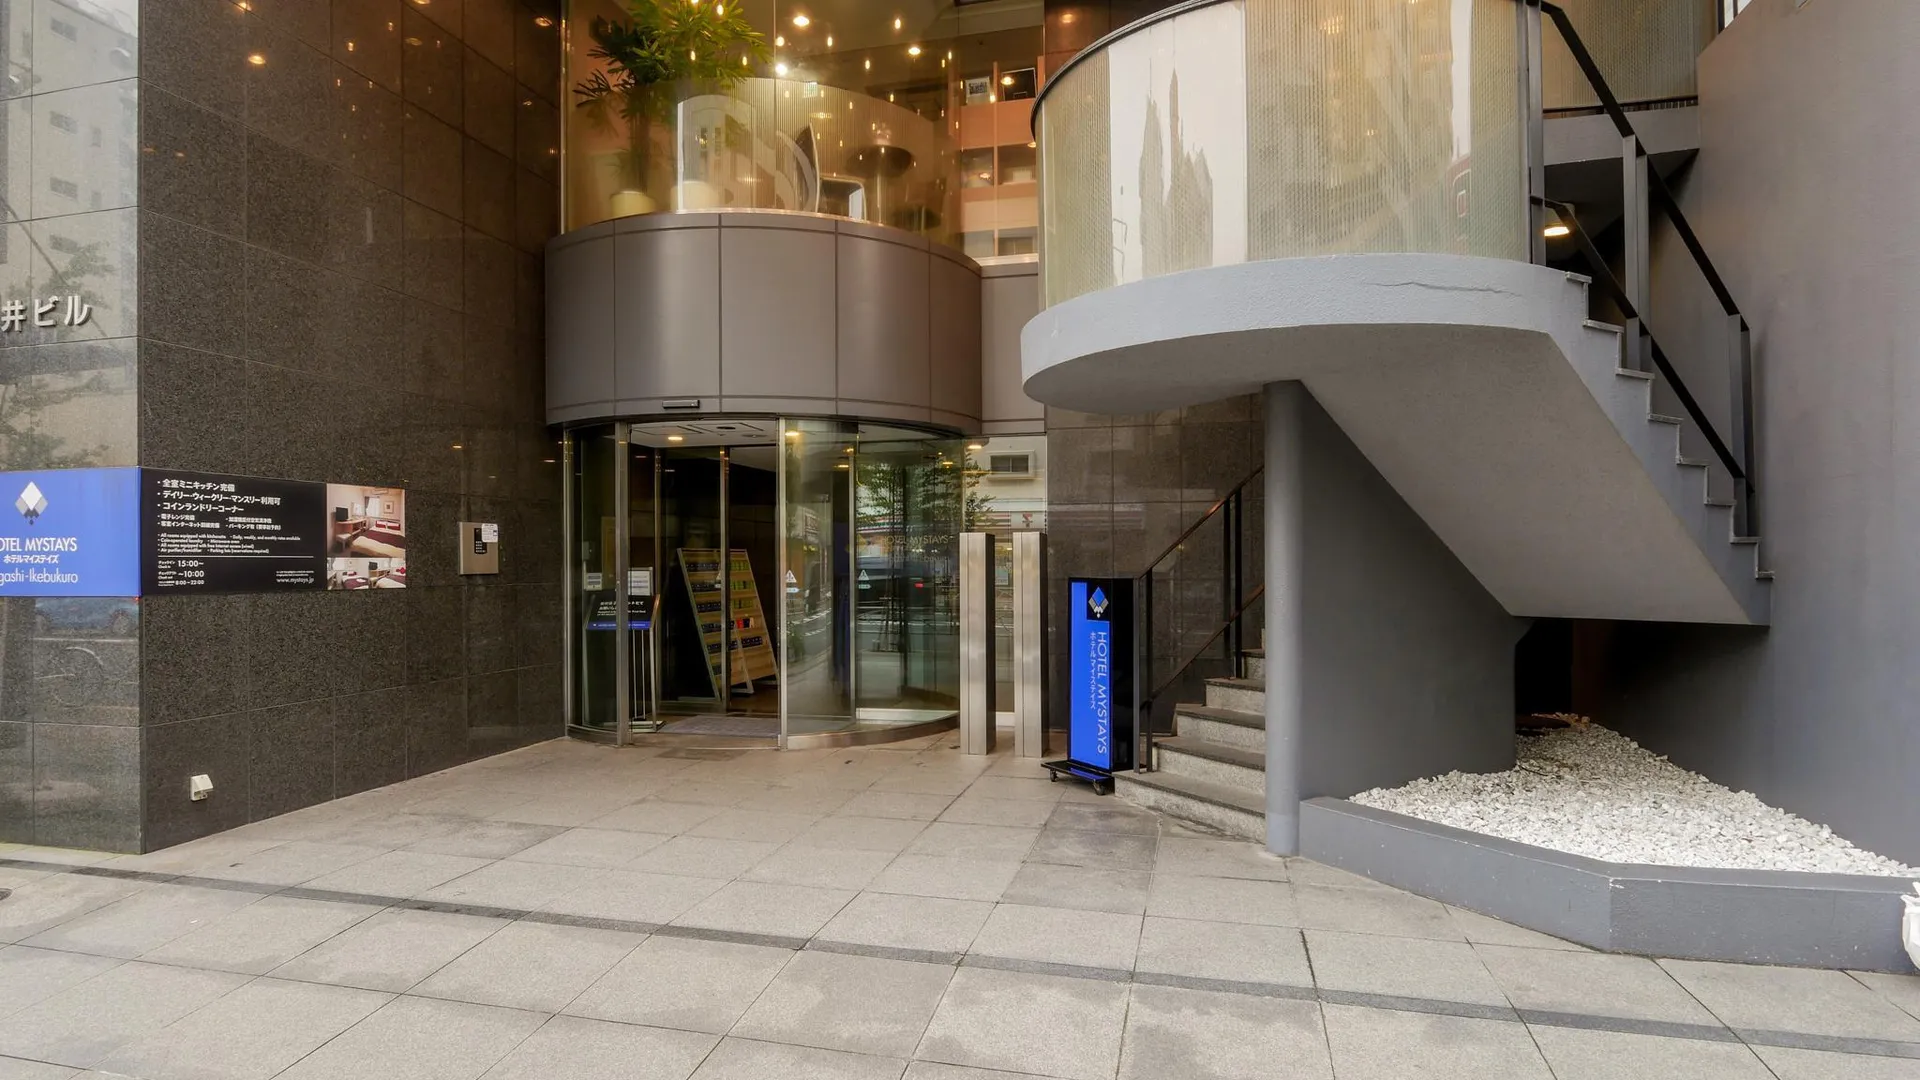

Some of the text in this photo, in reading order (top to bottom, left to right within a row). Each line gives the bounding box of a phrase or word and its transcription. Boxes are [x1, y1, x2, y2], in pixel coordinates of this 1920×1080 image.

[1, 295, 91, 332] 井ビル
[162, 478, 235, 492] 全室ミニキッチン完備
[162, 502, 244, 513] コインランドリーコーナー
[25, 538, 78, 552] MYSTAYS
[910, 535, 948, 544] MYSTAYS
[3, 554, 59, 564] ホテルマイステイズ
[1097, 631, 1107, 754] HOTEL MYSTAYS
